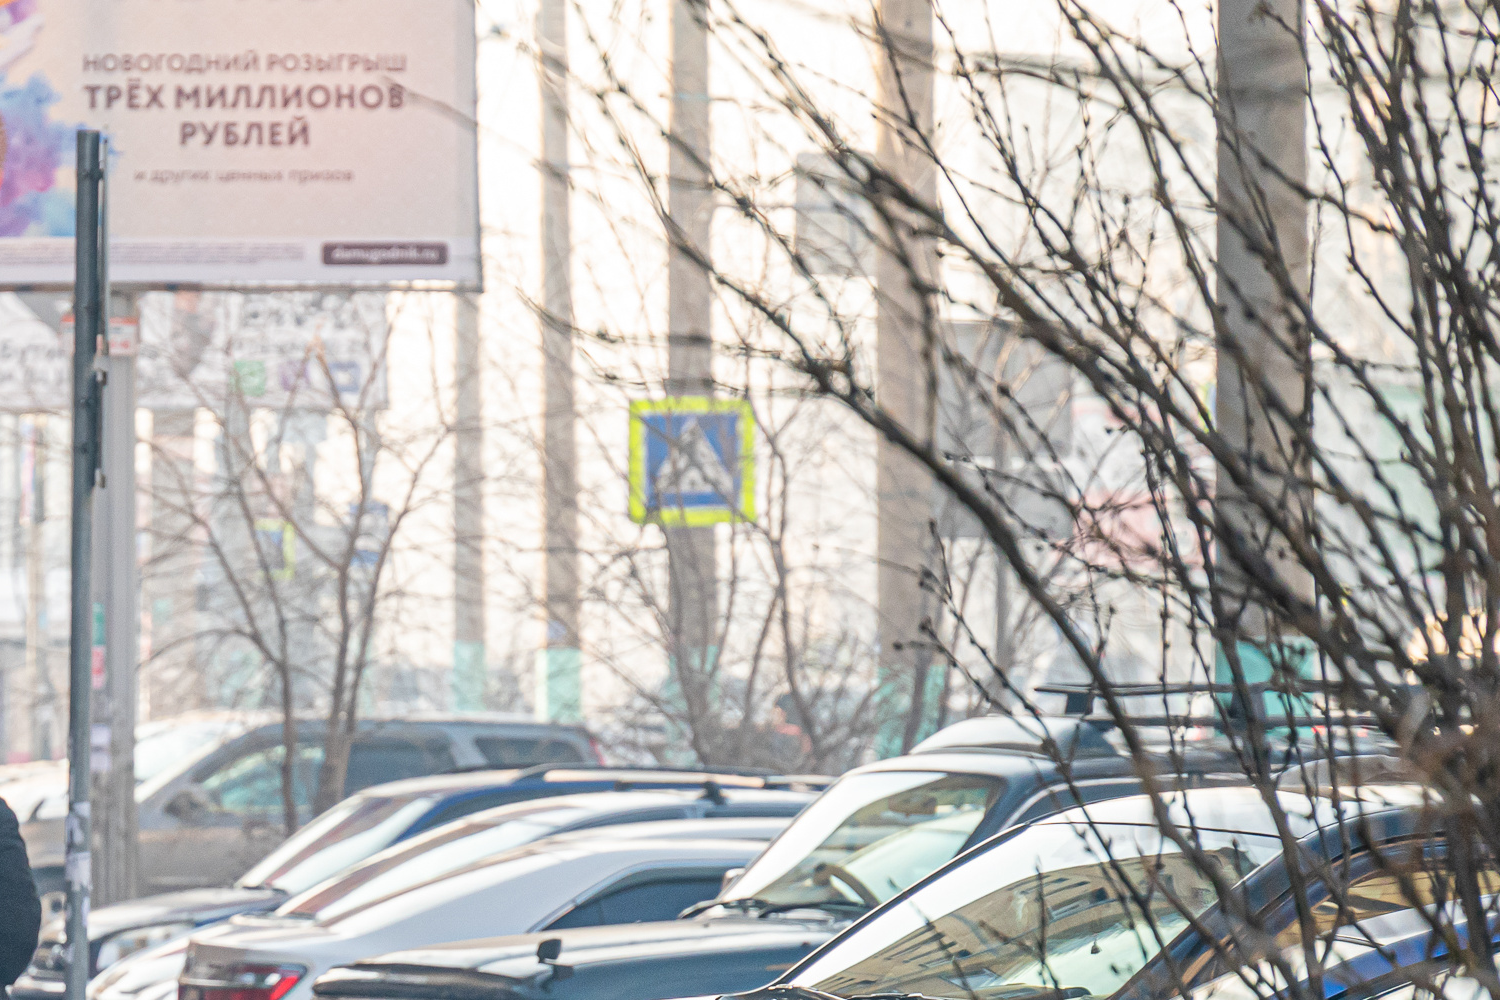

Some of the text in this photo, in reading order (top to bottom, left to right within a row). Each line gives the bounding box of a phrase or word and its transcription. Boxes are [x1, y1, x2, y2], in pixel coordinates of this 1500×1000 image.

[83, 50, 408, 73] НОВОГОДНИЙ РОЗЫГРЫШ
[84, 78, 405, 110] ТРЁХ МИЛЛИОНОВ
[180, 116, 311, 147] РУБЛЕЙ
